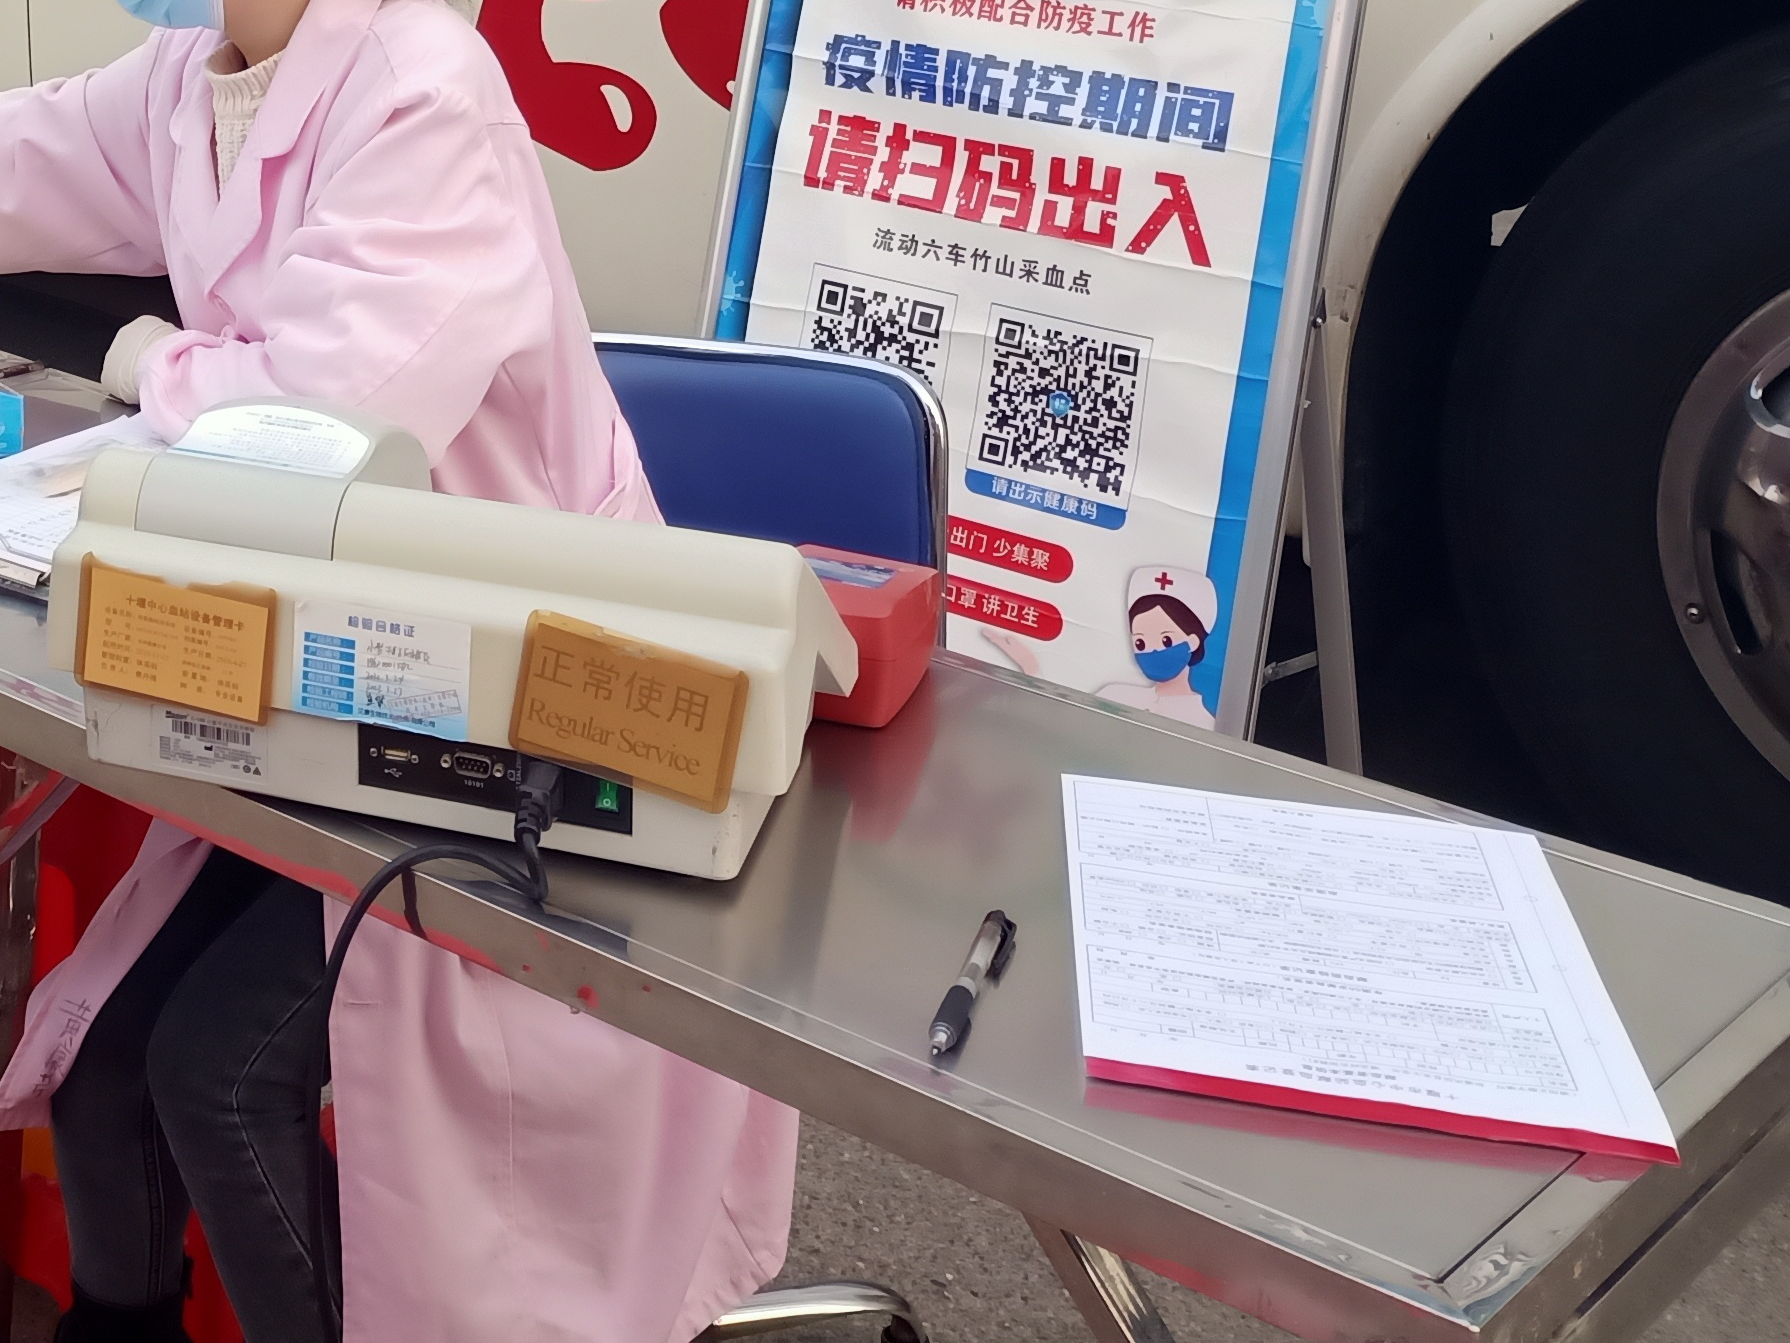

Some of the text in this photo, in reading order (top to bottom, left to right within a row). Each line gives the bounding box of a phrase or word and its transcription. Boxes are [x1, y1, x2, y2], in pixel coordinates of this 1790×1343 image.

[822, 33, 1235, 152] 疫情防控期间
[803, 108, 1212, 268] 请扫码出入
[872, 227, 1092, 296] 流动六车竹山采血点
[991, 475, 1099, 520] 请出示健康码
[948, 525, 1050, 572] 出门 少集聚
[981, 593, 1040, 628] 讲卫生
[533, 644, 709, 733] 正常使用
[527, 697, 701, 777] Regular Service
